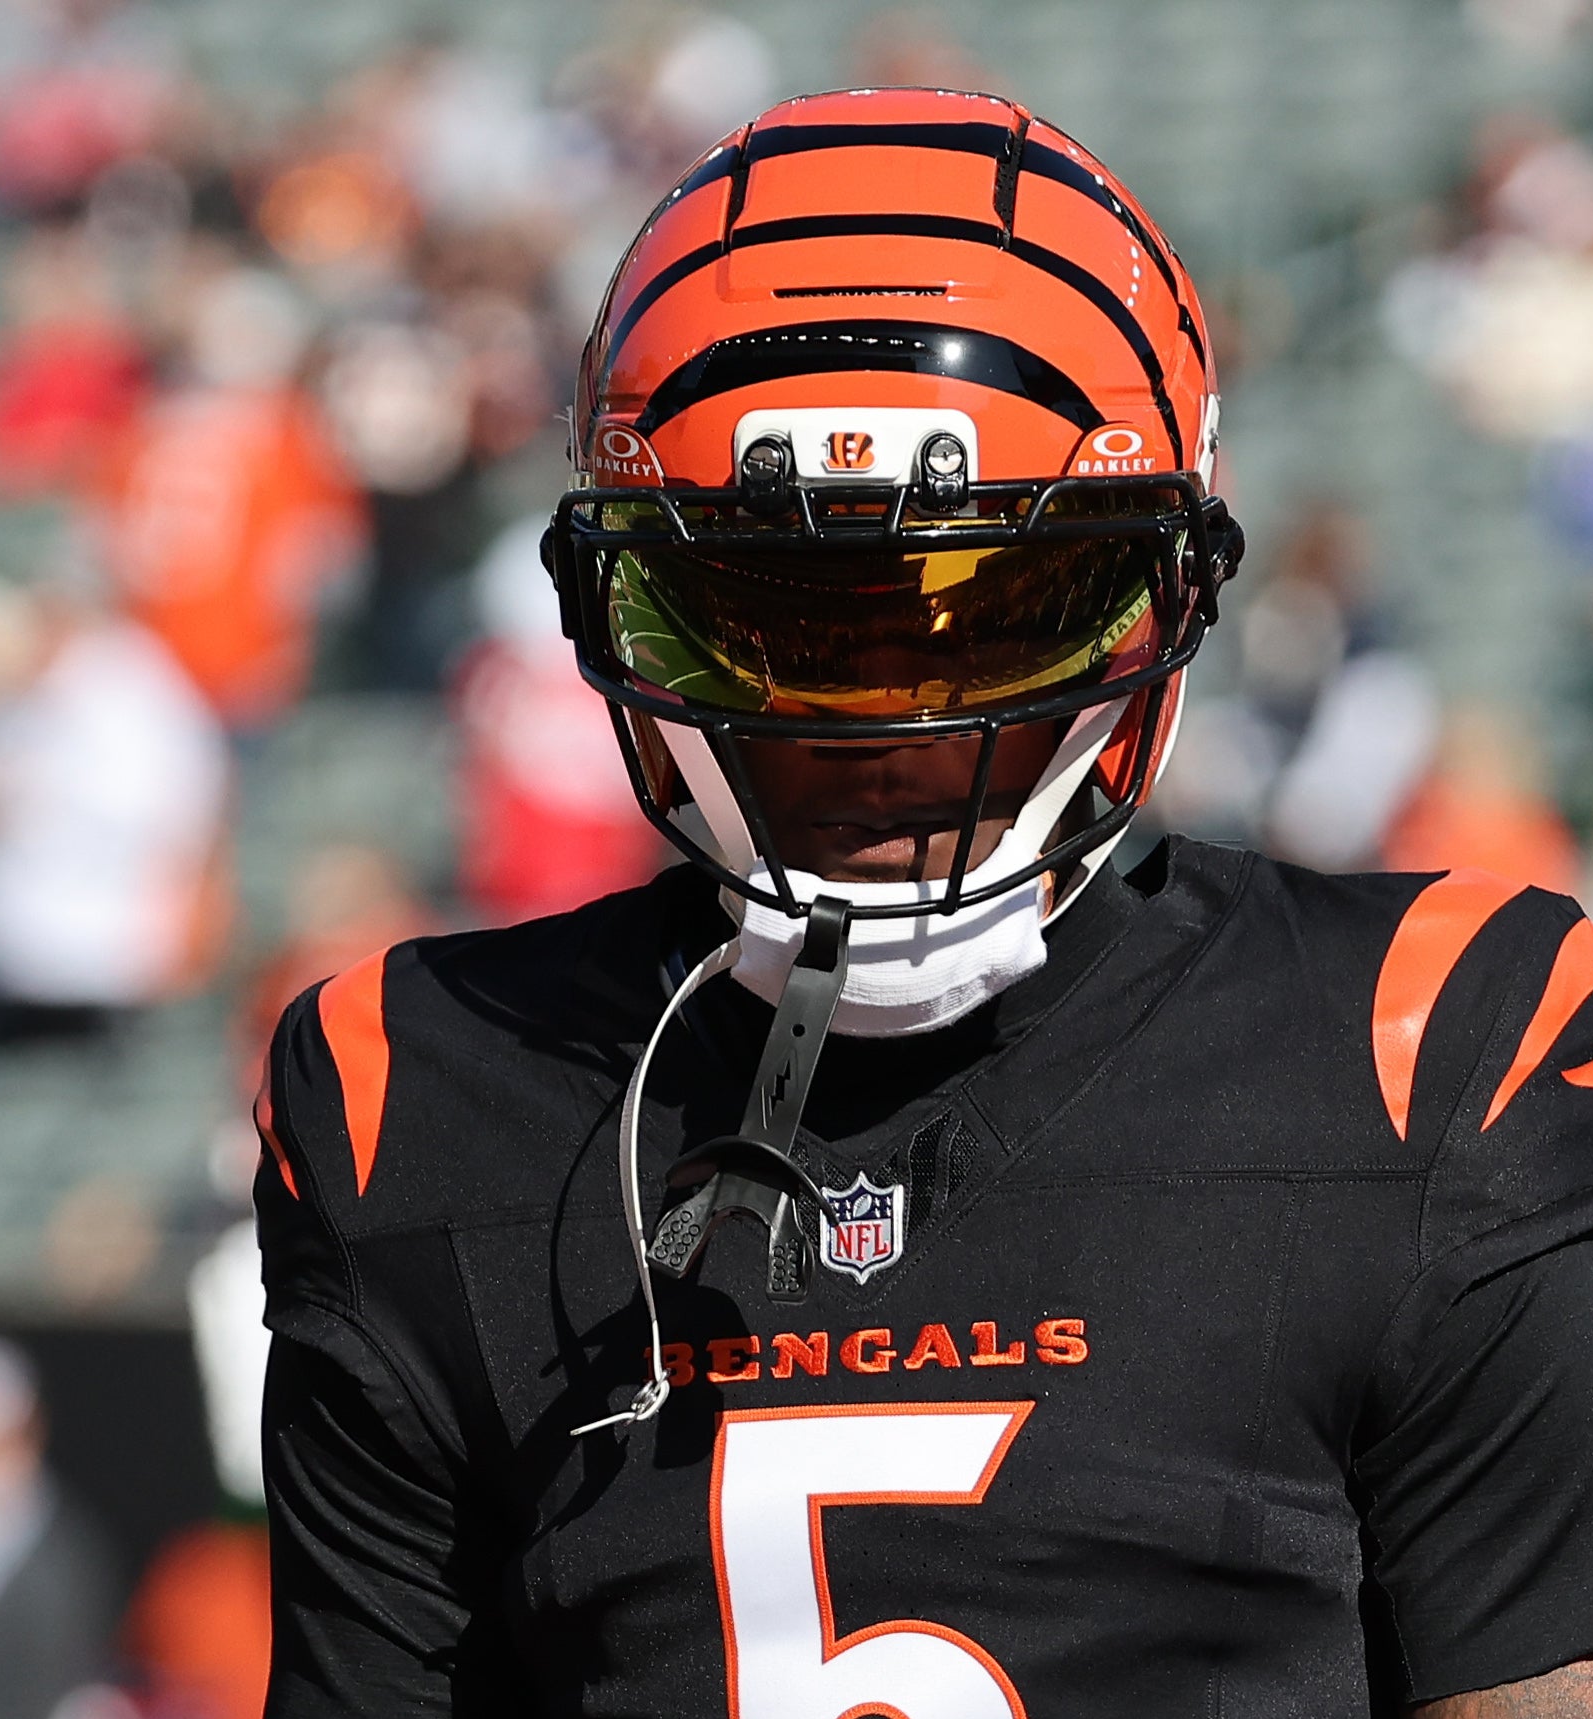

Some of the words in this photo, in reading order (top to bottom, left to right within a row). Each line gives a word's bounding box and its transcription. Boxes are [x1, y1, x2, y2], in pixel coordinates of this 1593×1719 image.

[595, 455, 652, 477] OAKLEY
[1077, 457, 1154, 474] OAKLEY
[833, 1223, 889, 1262] NFL
[642, 1317, 1092, 1388] BENGALS
